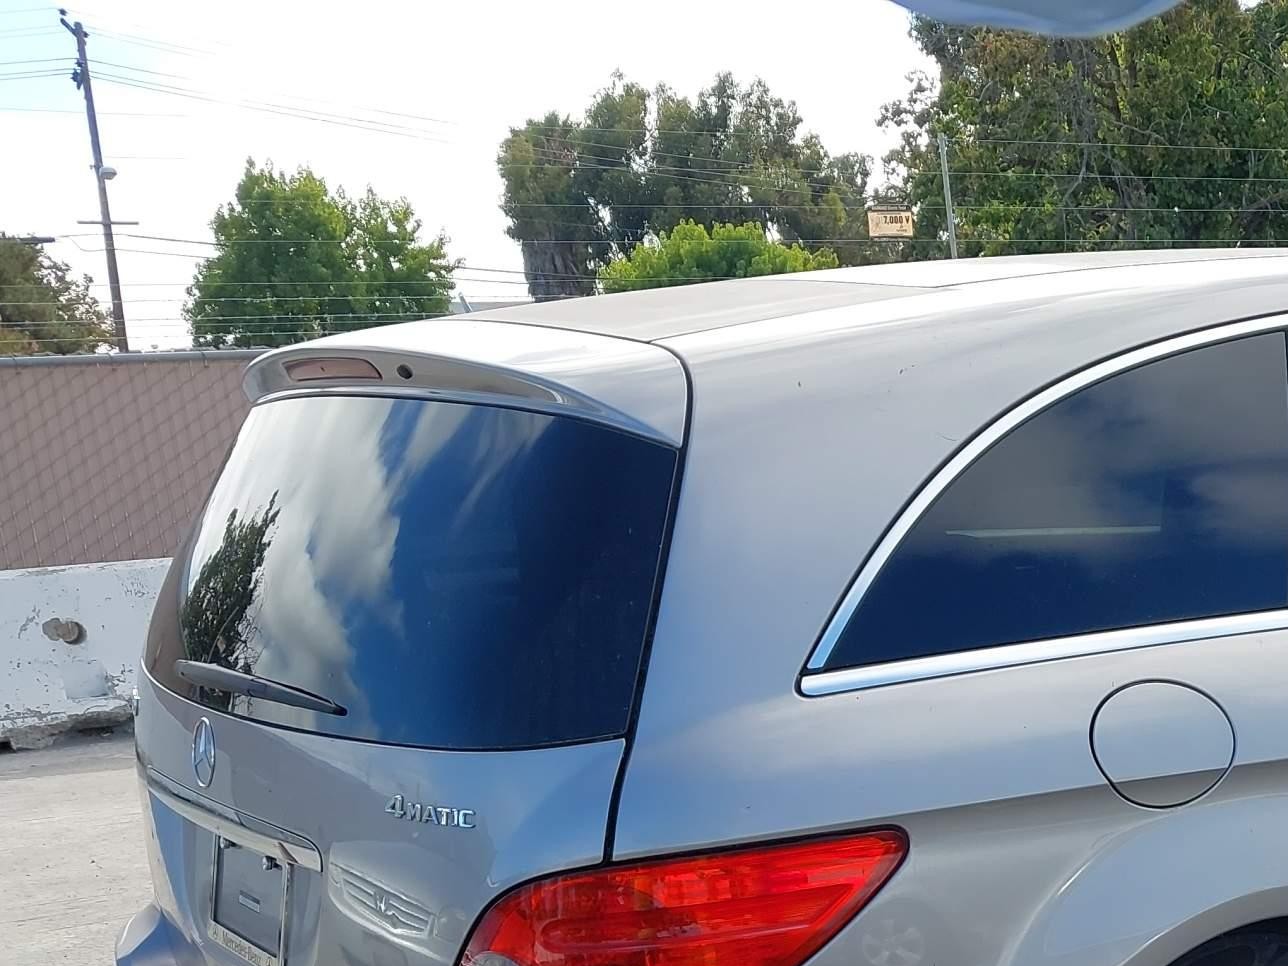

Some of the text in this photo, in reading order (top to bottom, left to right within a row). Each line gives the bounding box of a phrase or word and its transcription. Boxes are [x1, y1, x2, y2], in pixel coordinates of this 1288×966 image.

[883, 215, 910, 225] 7,000 V
[384, 794, 476, 828] 4MATIC
